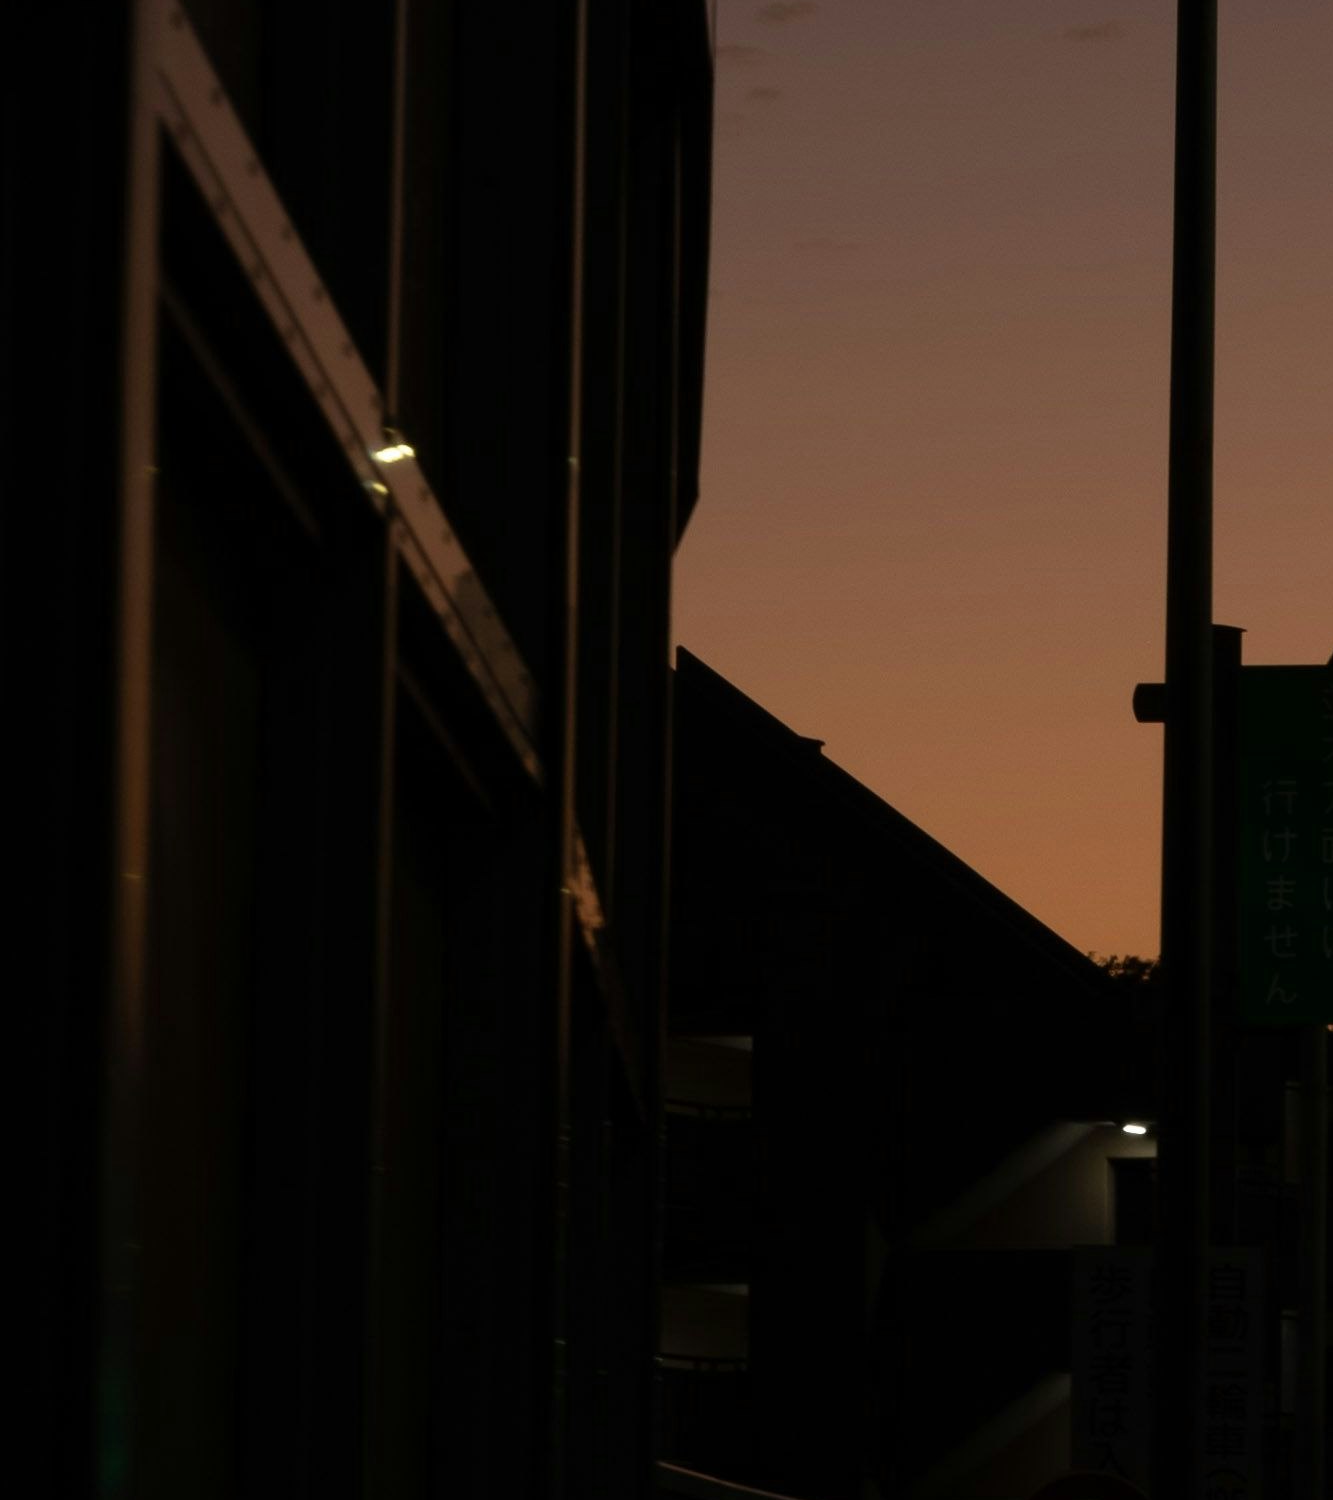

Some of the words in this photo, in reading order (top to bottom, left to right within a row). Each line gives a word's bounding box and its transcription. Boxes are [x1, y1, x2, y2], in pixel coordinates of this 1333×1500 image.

[1257, 774, 1301, 1007] 行けません
